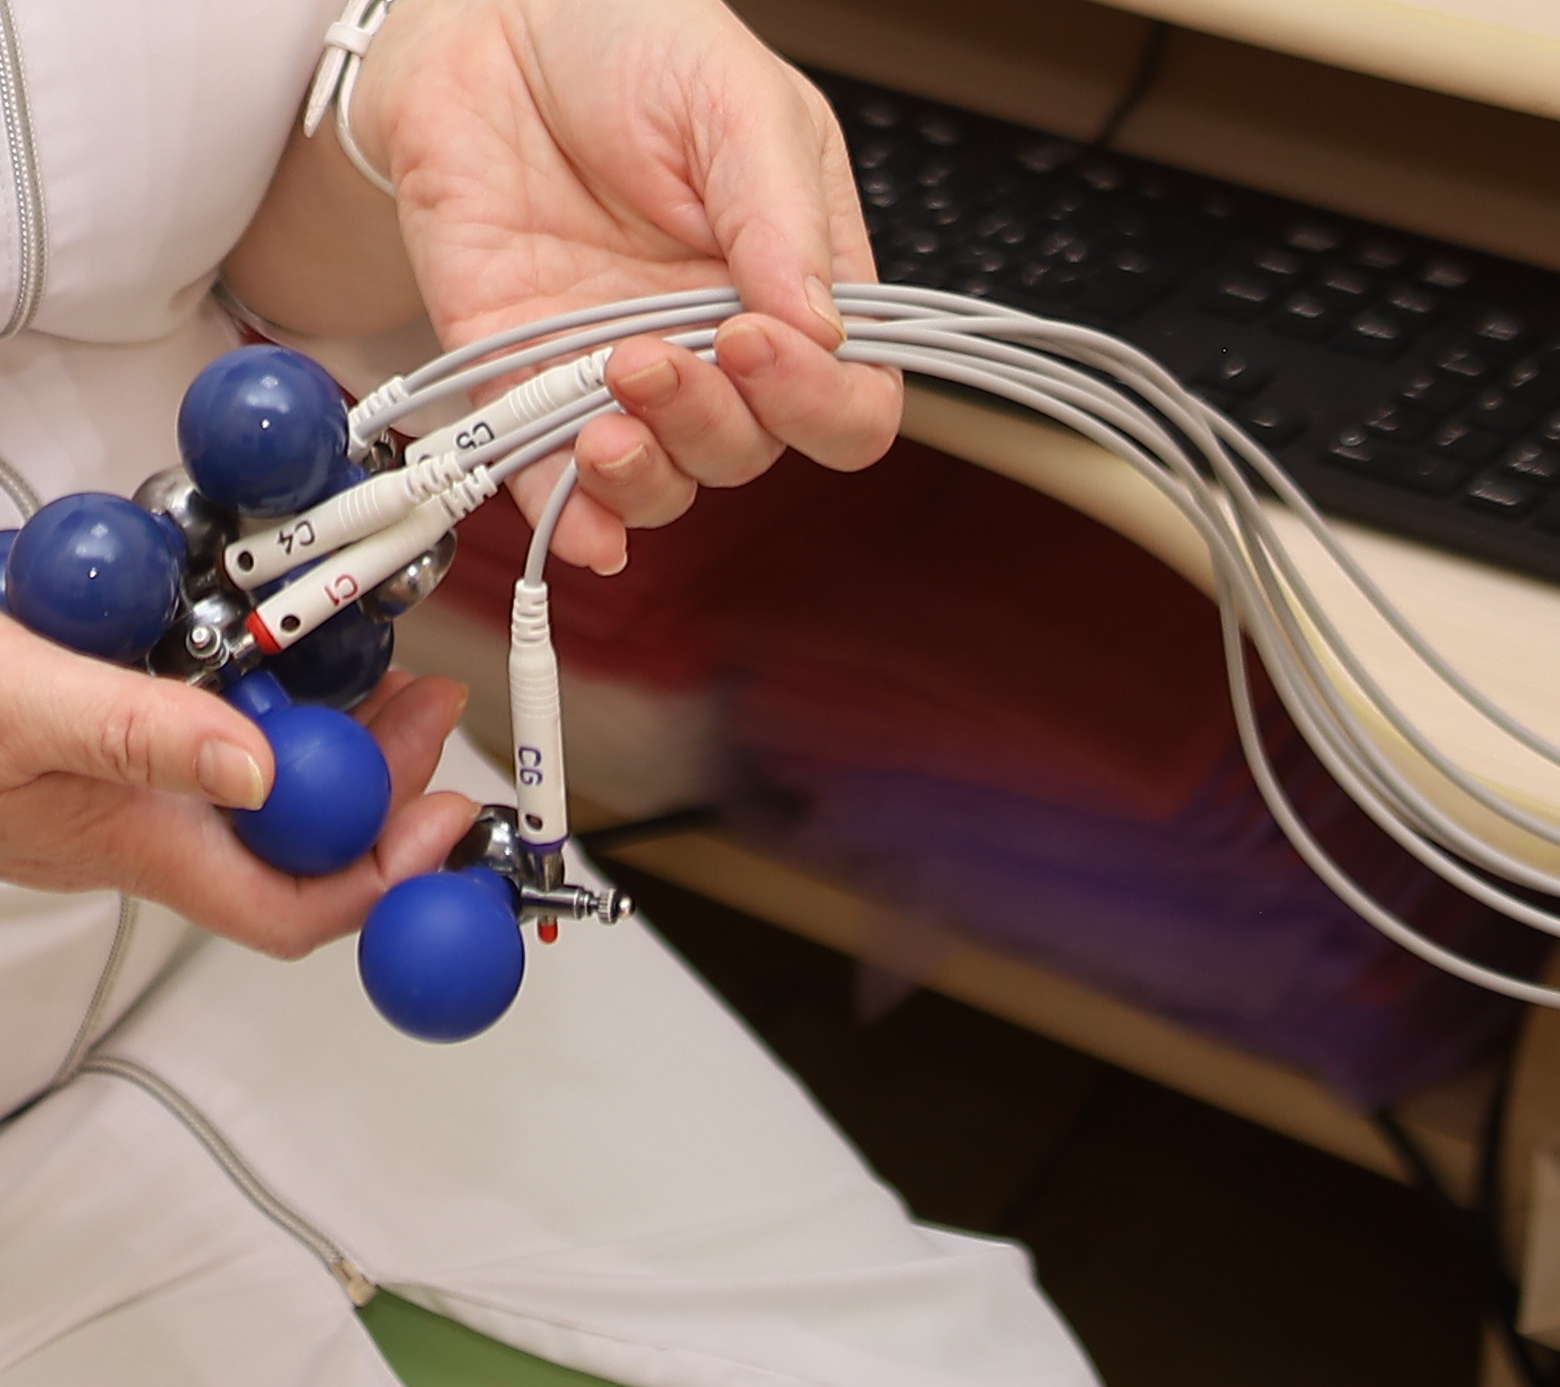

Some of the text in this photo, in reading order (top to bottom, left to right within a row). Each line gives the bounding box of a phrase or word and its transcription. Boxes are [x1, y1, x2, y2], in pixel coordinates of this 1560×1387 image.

[456, 422, 495, 449] C5
[277, 520, 315, 555] C4
[324, 574, 358, 606] C1
